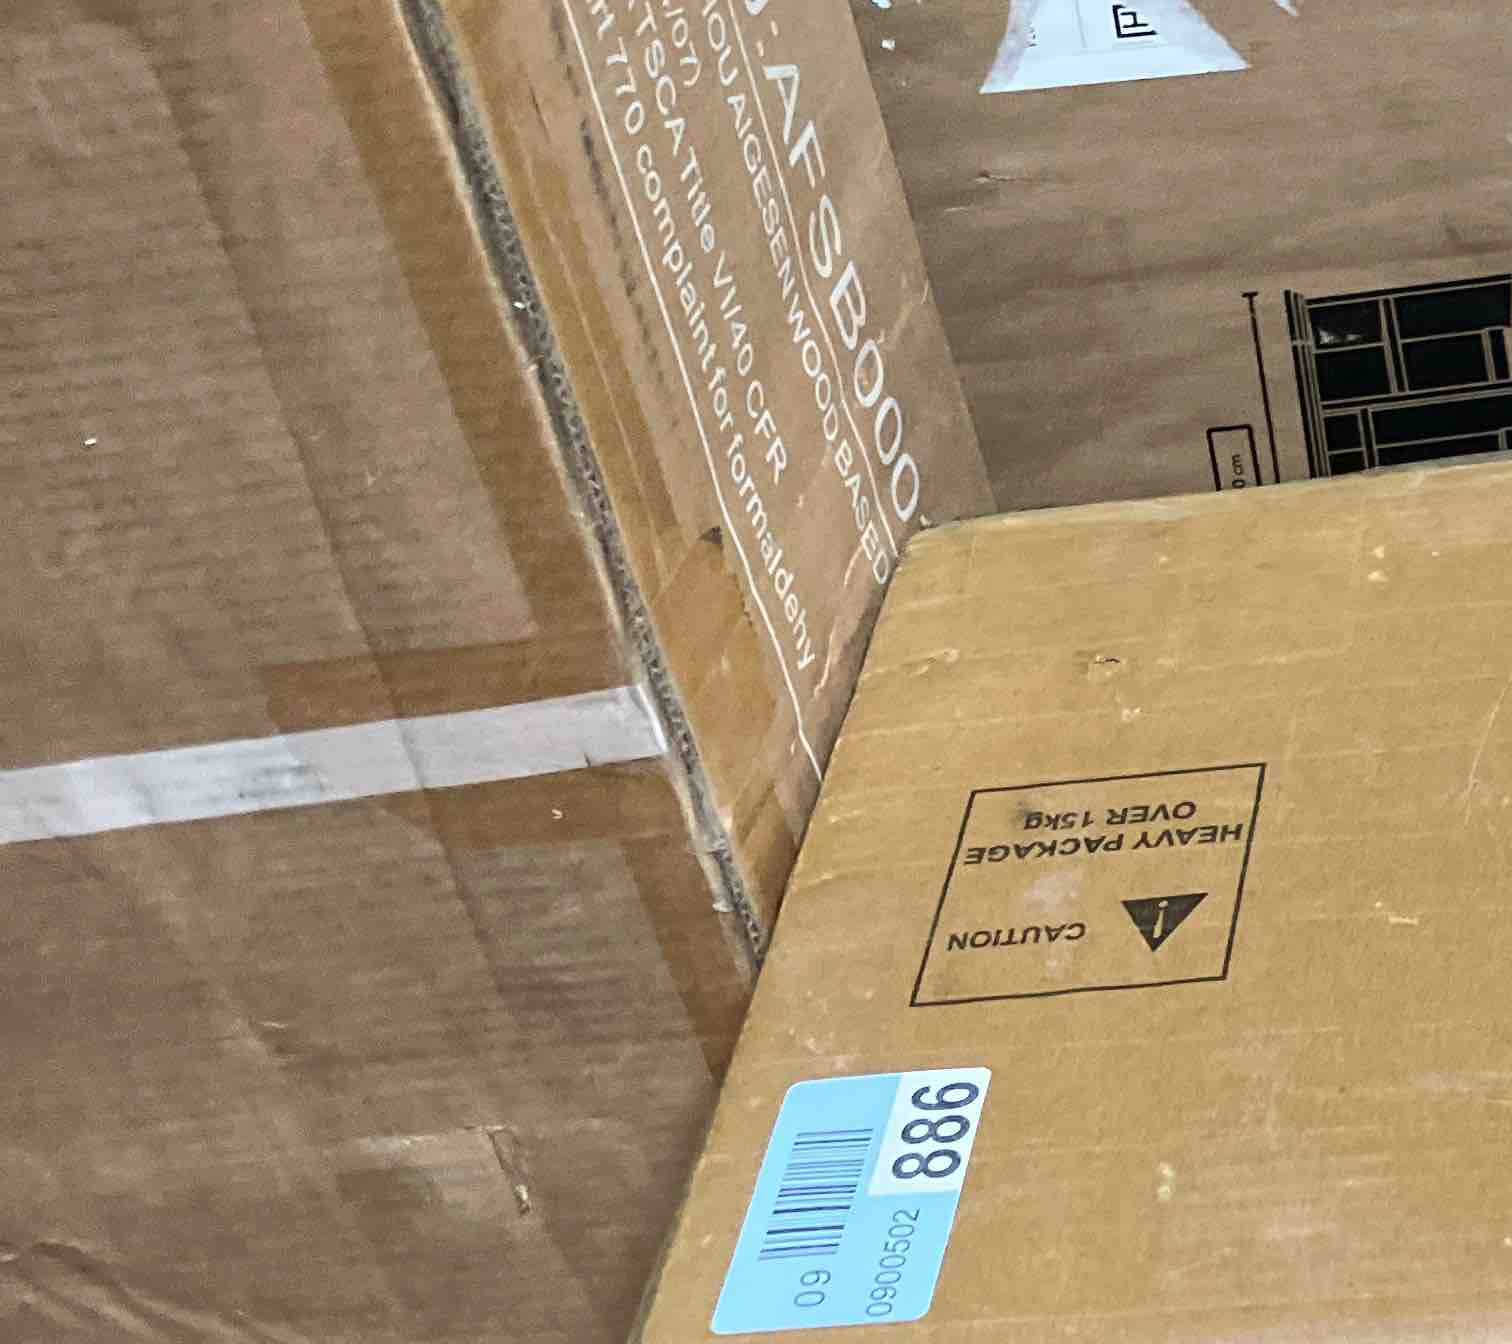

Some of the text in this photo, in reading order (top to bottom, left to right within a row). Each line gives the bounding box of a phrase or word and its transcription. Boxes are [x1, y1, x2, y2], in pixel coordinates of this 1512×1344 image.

[635, 0, 687, 157] TSCA
[679, 145, 716, 254] Title
[711, 250, 754, 378] VI/40
[745, 379, 789, 487] CFR
[605, 36, 646, 136] 770
[636, 143, 716, 374] complaint
[708, 365, 736, 435] for
[726, 432, 817, 671] formaldehy
[727, 94, 797, 302] AIGESEN
[786, 293, 840, 442] WOOD
[833, 438, 891, 586] BASED
[963, 823, 1244, 865] HEAVY PACKAGE
[1023, 800, 1197, 831] OVER 15kg
[946, 922, 1087, 951] CAUTION
[891, 1081, 980, 1179] 886
[793, 1268, 831, 1308] 09
[865, 1207, 921, 1318] 0900502
